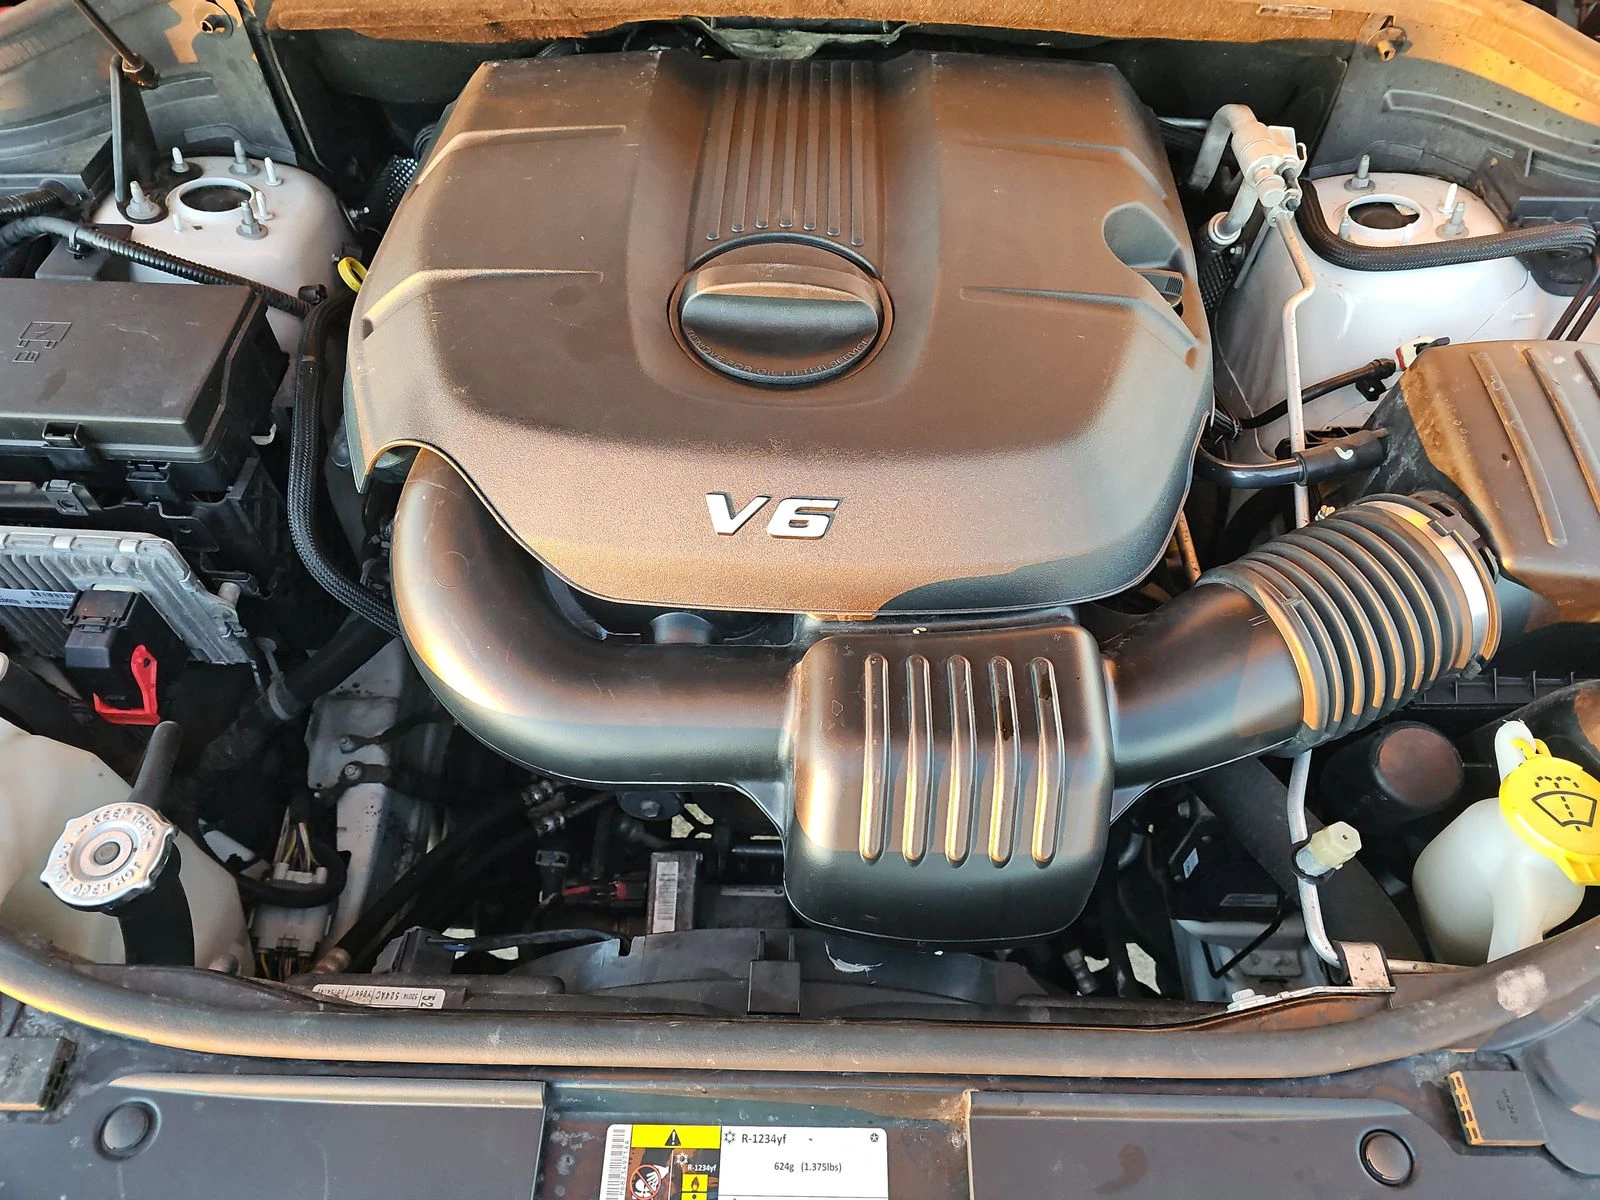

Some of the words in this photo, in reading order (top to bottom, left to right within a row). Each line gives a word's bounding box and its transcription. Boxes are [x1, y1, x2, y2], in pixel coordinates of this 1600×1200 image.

[705, 490, 844, 540] V6
[741, 1133, 788, 1146] R-1234yf
[687, 1164, 717, 1172] R-1234yf
[774, 1161, 795, 1173] 624g
[800, 1161, 843, 1174] (1.375lbs)
